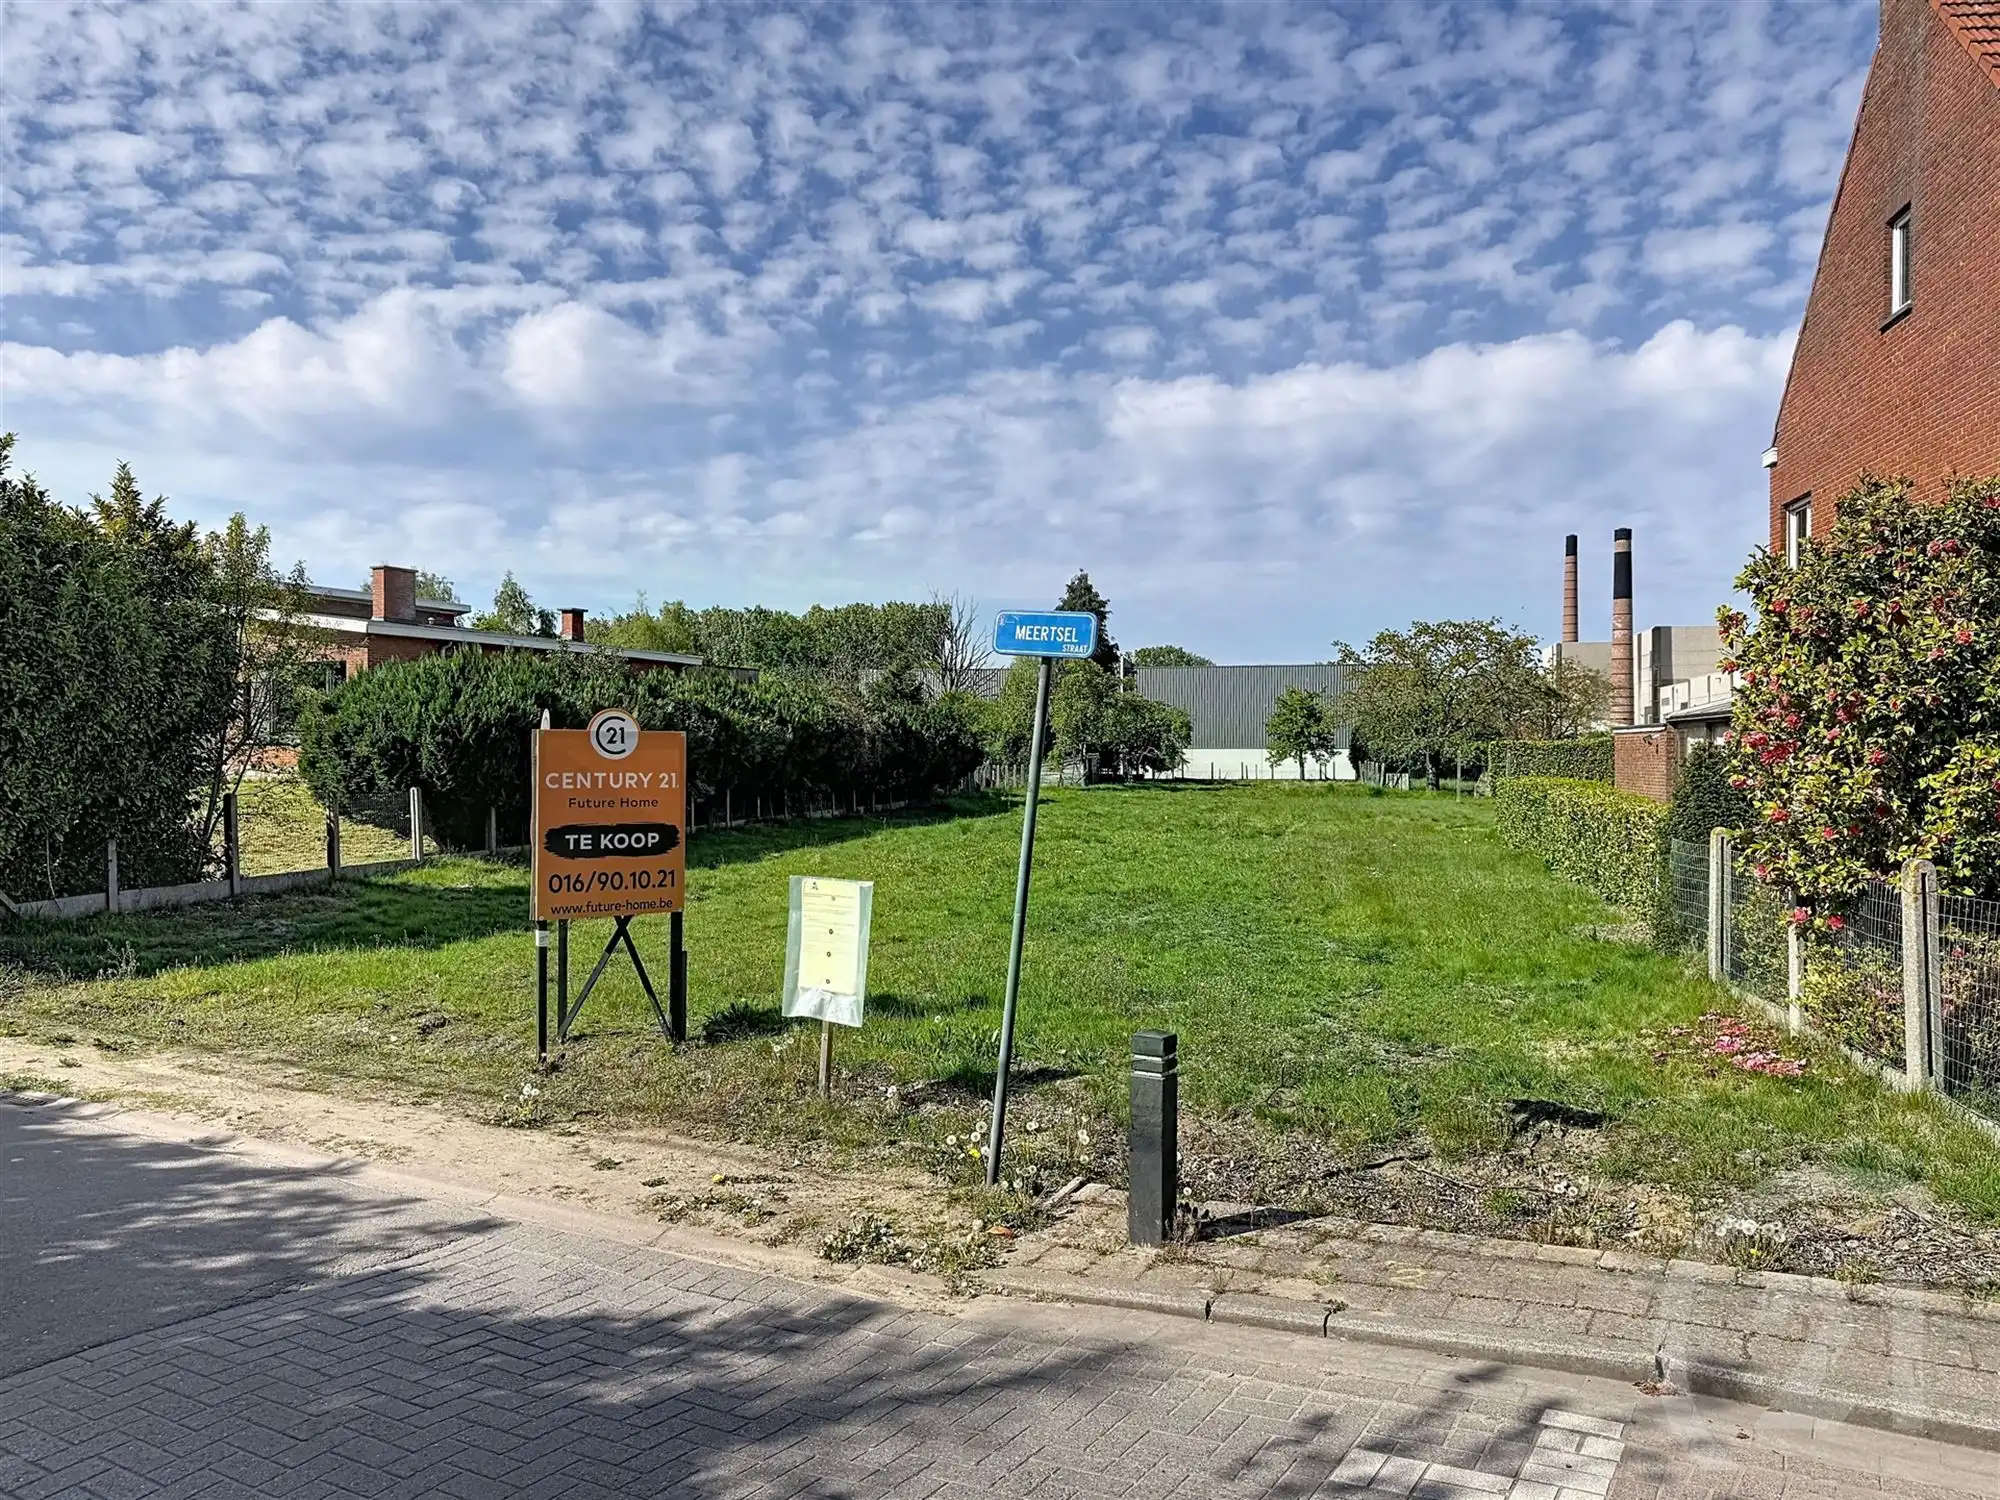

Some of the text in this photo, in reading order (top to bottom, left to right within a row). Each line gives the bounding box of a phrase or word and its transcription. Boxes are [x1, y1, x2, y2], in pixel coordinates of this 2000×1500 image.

[1015, 624, 1079, 643] MEERTSEL
[1062, 644, 1088, 654] STRAAT
[545, 771, 654, 789] CENTURY
[568, 797, 659, 809] Future Home
[564, 832, 660, 850] TE KOOP
[548, 869, 676, 894] 016/90.10.21
[550, 897, 673, 915] www.future-home.be
